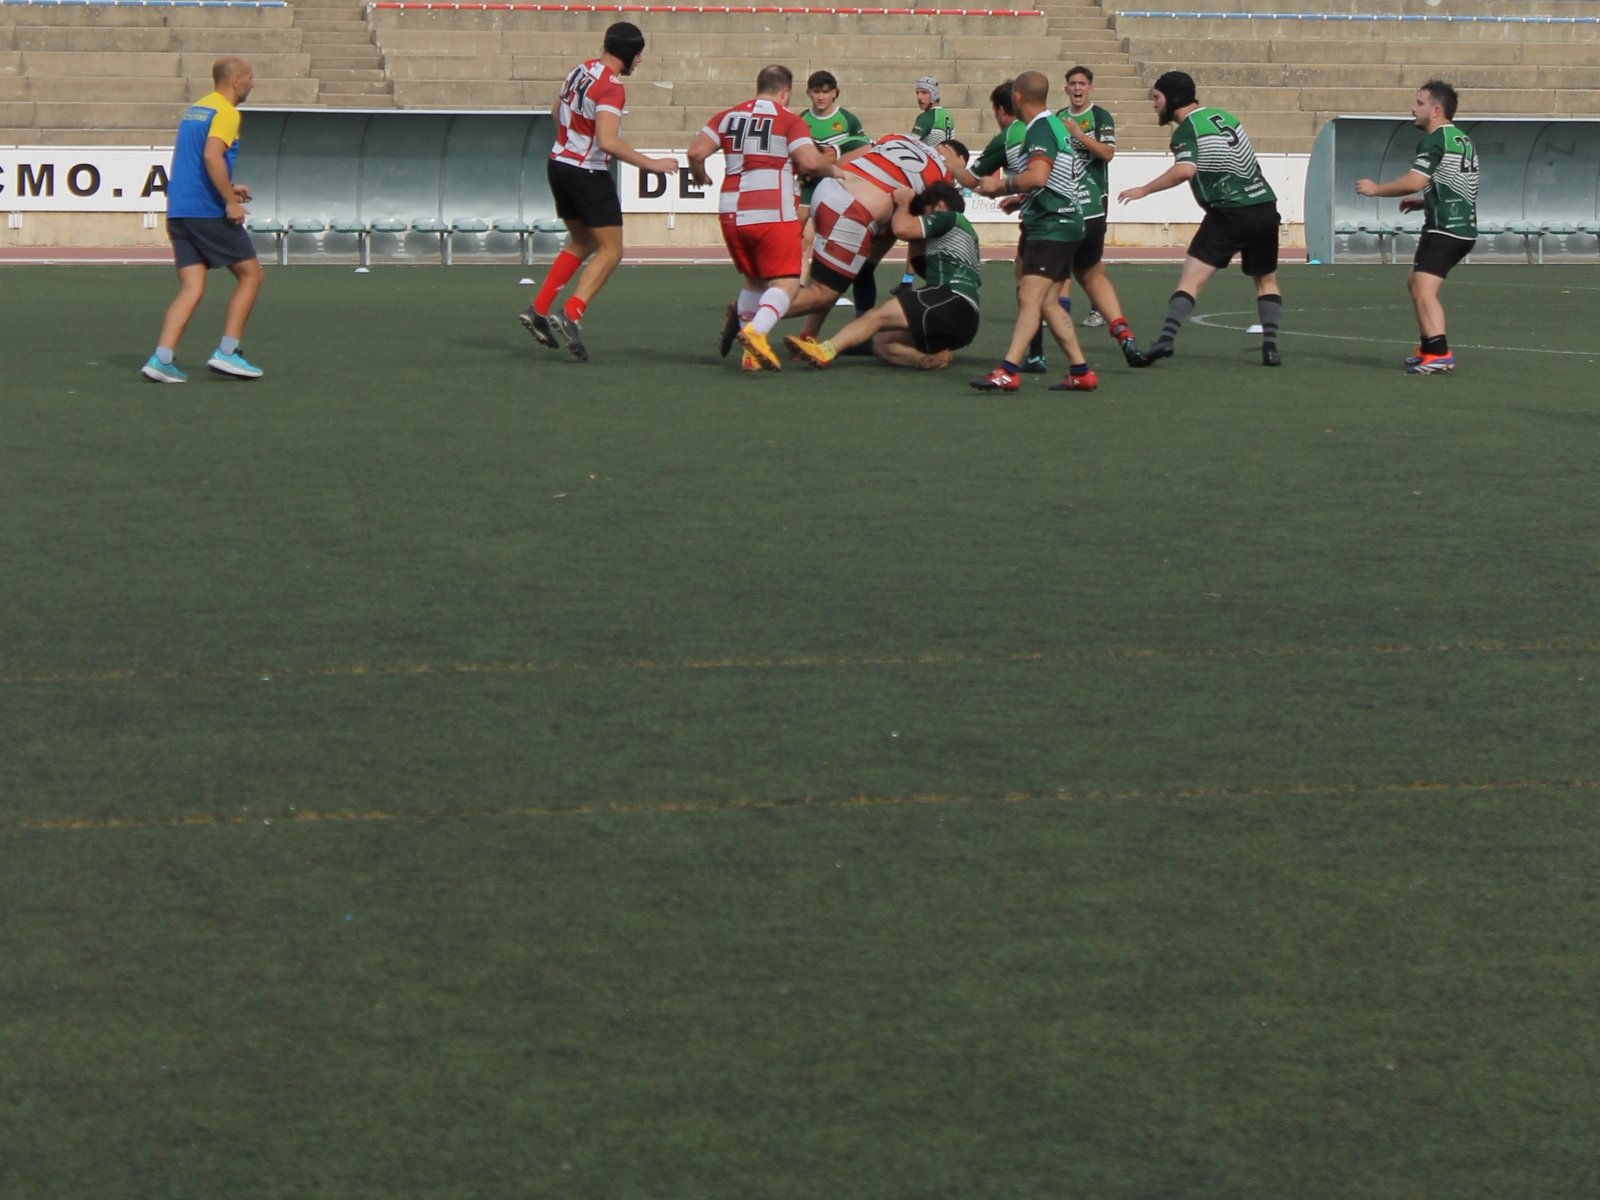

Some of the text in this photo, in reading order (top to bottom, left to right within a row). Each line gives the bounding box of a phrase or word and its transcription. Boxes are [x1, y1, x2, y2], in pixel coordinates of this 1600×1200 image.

[724, 117, 772, 152] 44
[1208, 114, 1239, 147] 5
[1454, 136, 1478, 173] 22
[639, 167, 705, 198] DE
